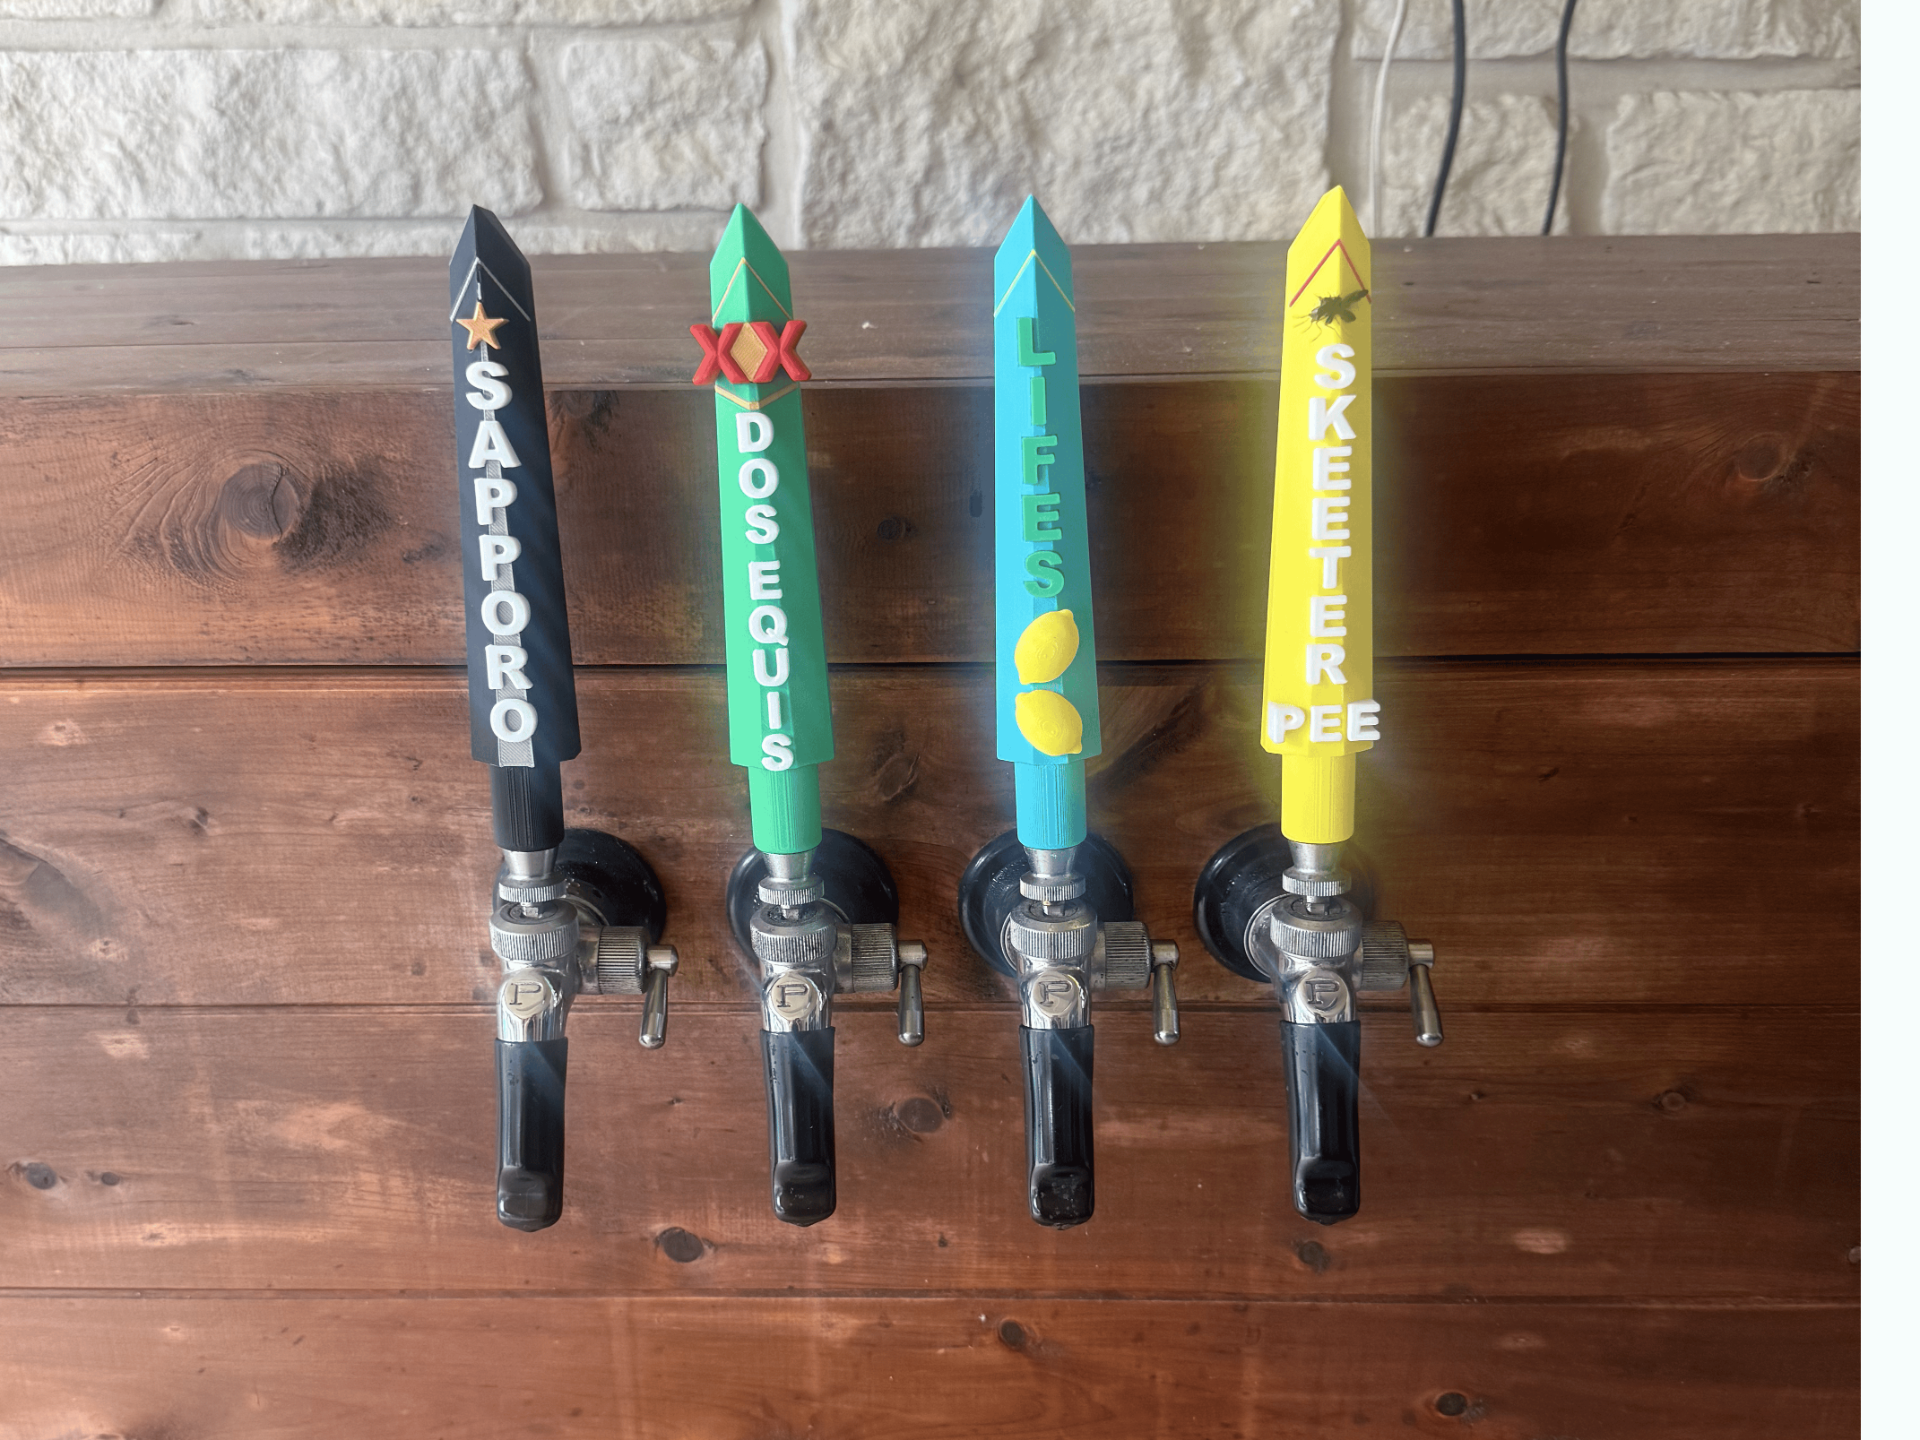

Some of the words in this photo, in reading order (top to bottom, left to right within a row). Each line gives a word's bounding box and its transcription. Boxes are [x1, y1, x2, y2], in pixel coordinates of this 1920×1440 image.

[736, 412, 780, 545] DOS
[1016, 317, 1064, 598] LIFES
[466, 361, 538, 743] SAPPORO
[1306, 343, 1357, 686] SKEETER
[747, 560, 794, 772] EQUIS
[1267, 699, 1381, 744] PEE
[509, 982, 542, 1005] P
[777, 984, 809, 1008] P
[1038, 980, 1072, 1005] P
[1305, 979, 1341, 1005] P
